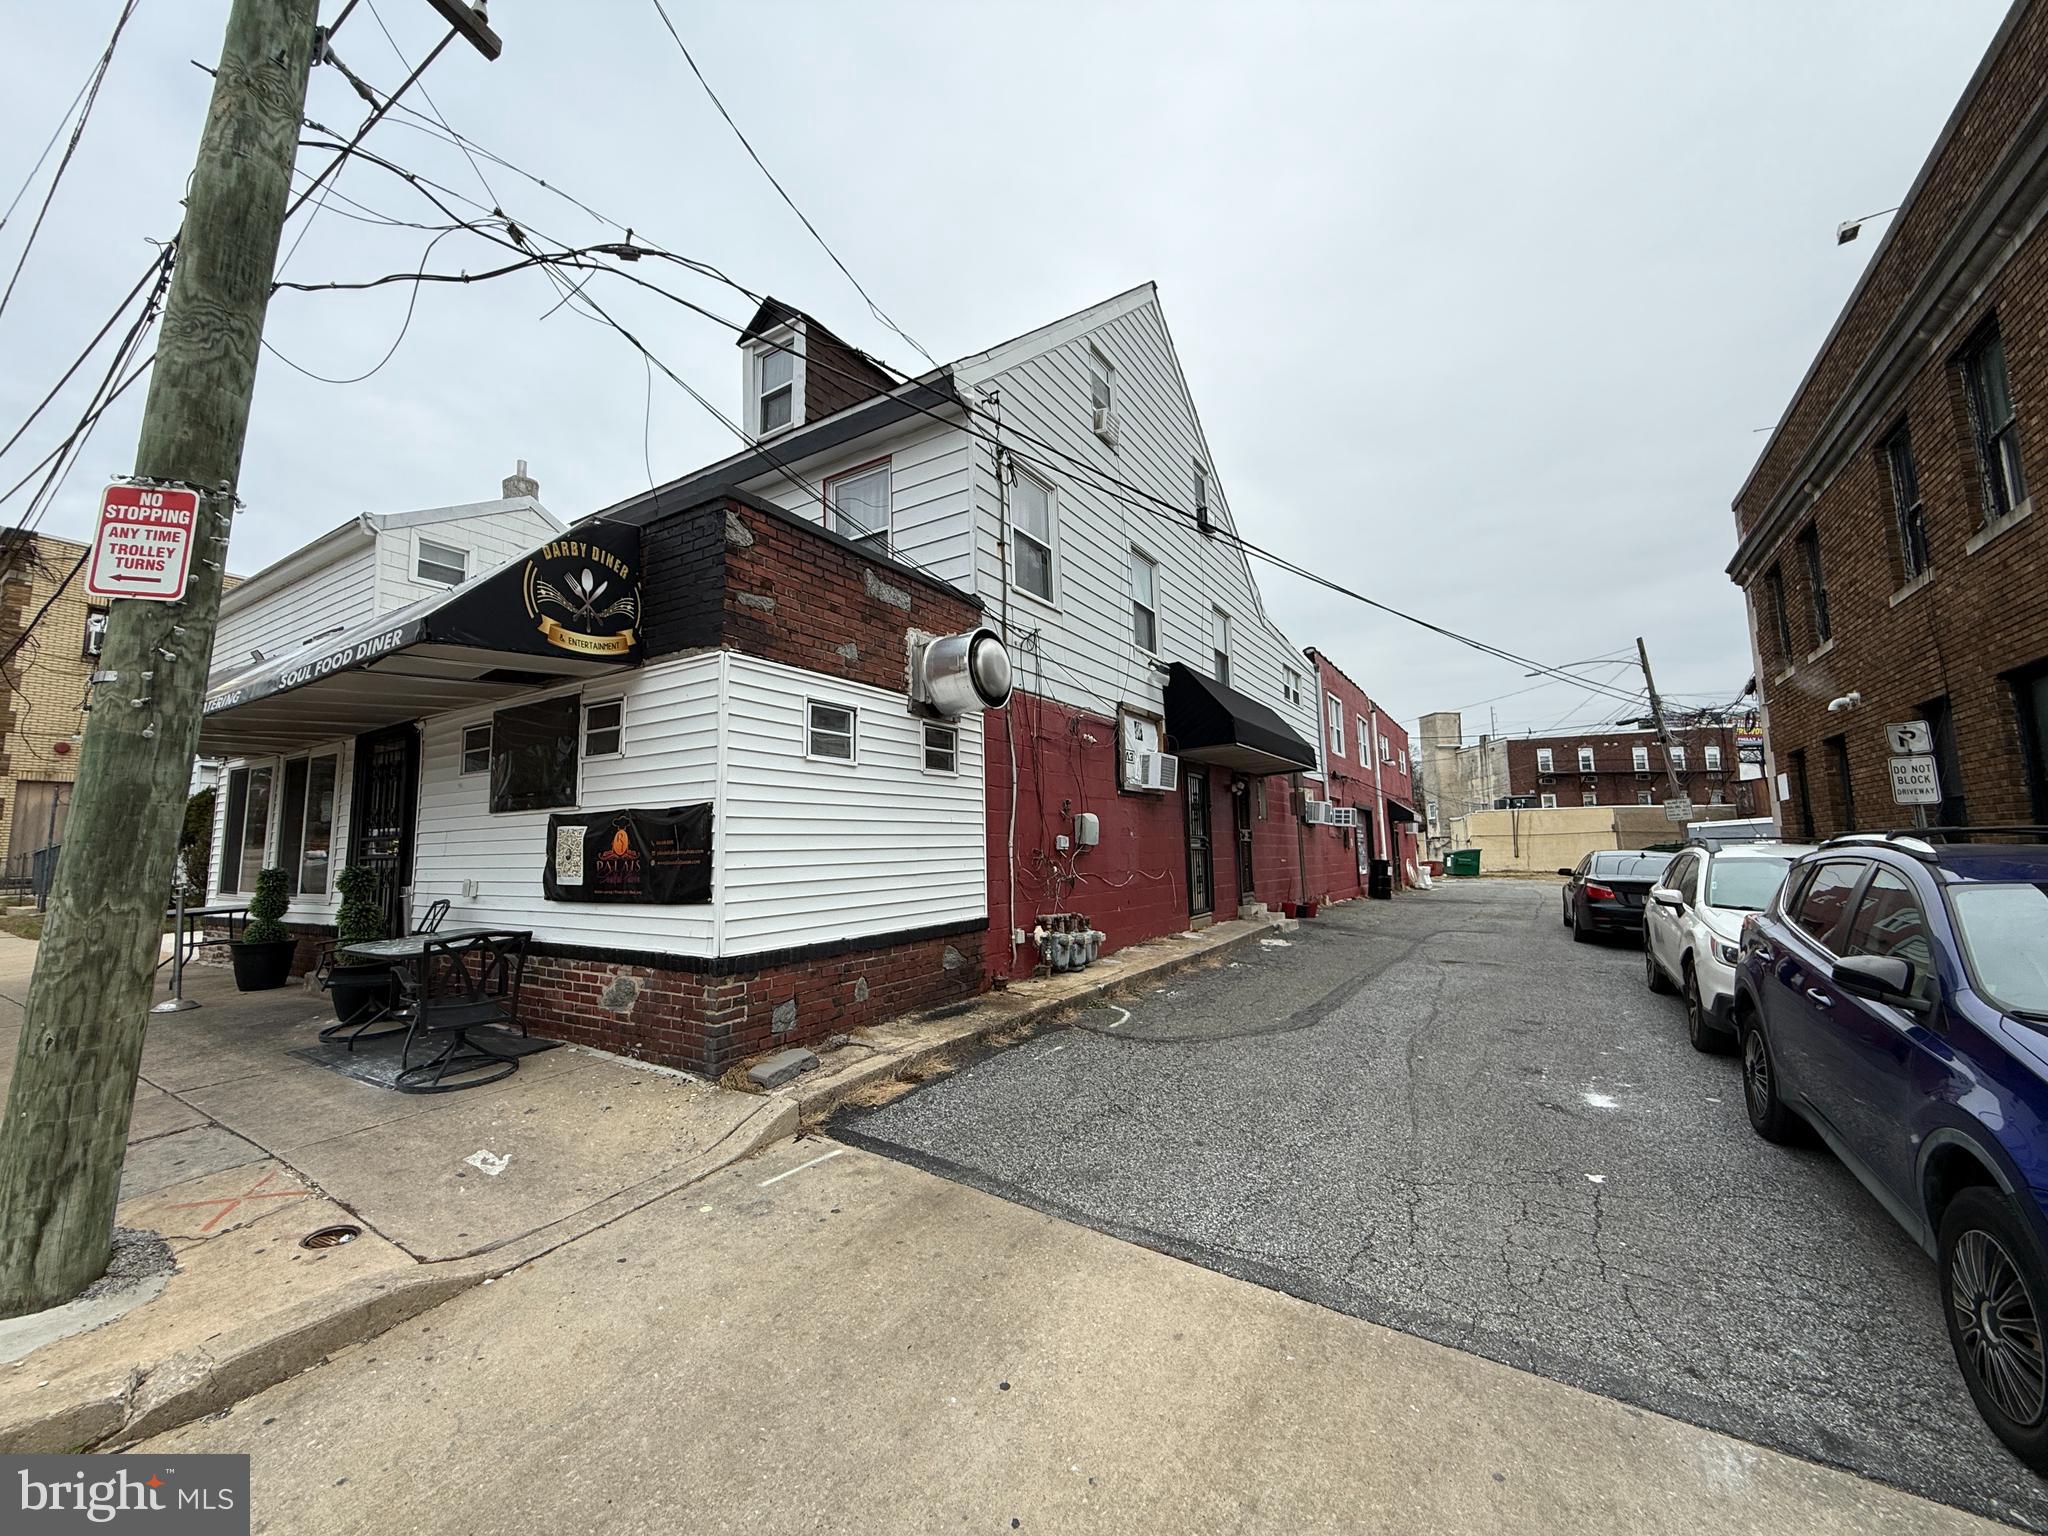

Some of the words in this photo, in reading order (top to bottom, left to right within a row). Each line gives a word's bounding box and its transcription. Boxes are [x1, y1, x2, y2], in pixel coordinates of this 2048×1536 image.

[139, 492, 163, 506] NO
[105, 504, 191, 525] STOPPING
[109, 527, 139, 539] ANY
[145, 529, 181, 542] TIME
[109, 542, 176, 559] TROLLEY
[115, 557, 166, 571] TURNS
[542, 541, 587, 560] DARBY
[592, 546, 629, 579] DINER
[559, 634, 565, 642] &
[568, 637, 620, 650] ENTERTAINMENT
[278, 663, 312, 689] SOUL
[314, 648, 353, 677] FOOD
[356, 628, 403, 661] DINER
[1893, 766, 1906, 774] DO
[1911, 764, 1930, 773] NOT
[1897, 775, 1931, 784] BLOCK
[1897, 787, 1934, 795] DRIVEWAY
